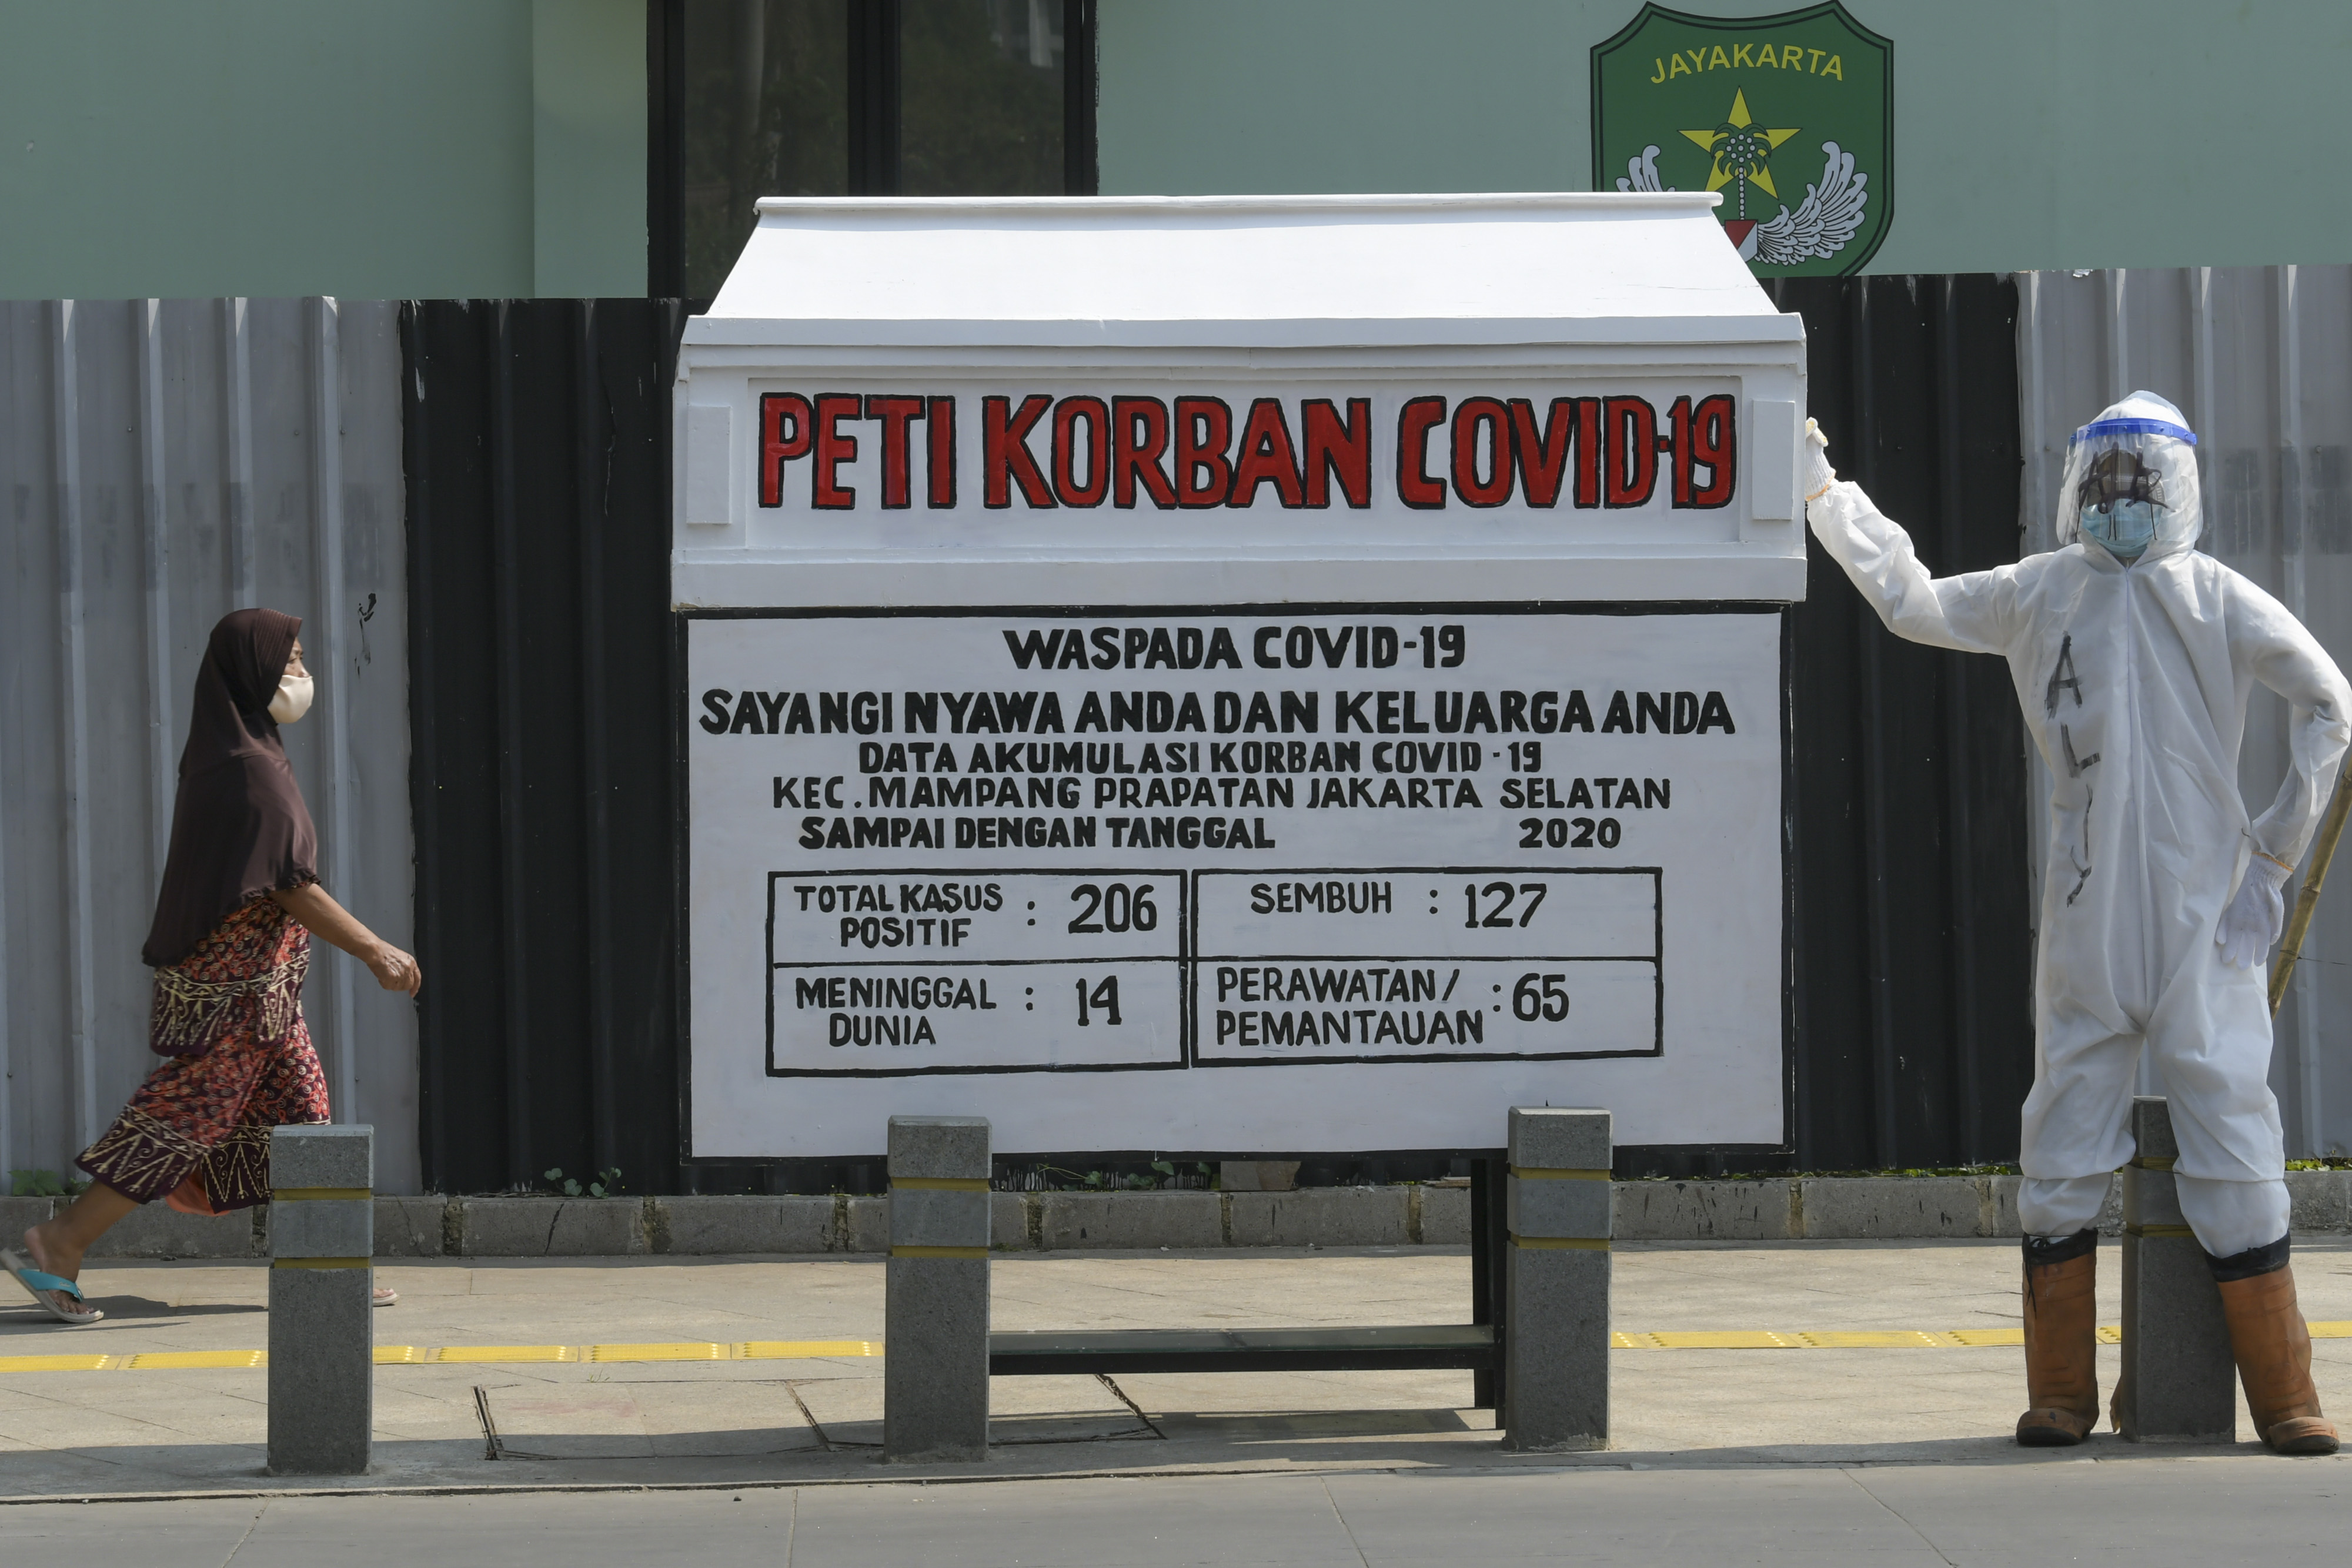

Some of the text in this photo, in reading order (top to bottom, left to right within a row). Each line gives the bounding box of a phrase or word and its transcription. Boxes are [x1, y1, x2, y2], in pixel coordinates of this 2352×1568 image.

[1649, 42, 1844, 85] JAYAKARTA
[757, 391, 1738, 511] PETI KORBAN COVID-19
[1002, 624, 1466, 671] WASPADA COVID-19
[699, 688, 1736, 735] SAYANGI NYAWA ANDA DAN KELUARGA ANDA
[858, 741, 958, 774] DATA
[967, 741, 1200, 775] AKUMULASI
[1210, 740, 1361, 774] KORBAN
[773, 775, 1671, 810] KEC. MAMPANG PRAPATAN JAKARTA SELATAN
[798, 815, 1622, 850] SAMPAI DENGAN TANGGAL 2020
[793, 884, 895, 914] TOTAL
[899, 882, 1004, 914] KASUS
[1067, 882, 1158, 934] 206
[1250, 881, 1392, 915] SEMBUH
[1464, 881, 1548, 929] 127
[840, 916, 972, 950] POSITIF
[795, 975, 997, 1011] MENINGGAL
[1075, 975, 1122, 1027] 14
[1512, 972, 1570, 1022] 65
[828, 1012, 937, 1048] DUNIA
[1216, 1009, 1484, 1047] PEMANTAUAN
